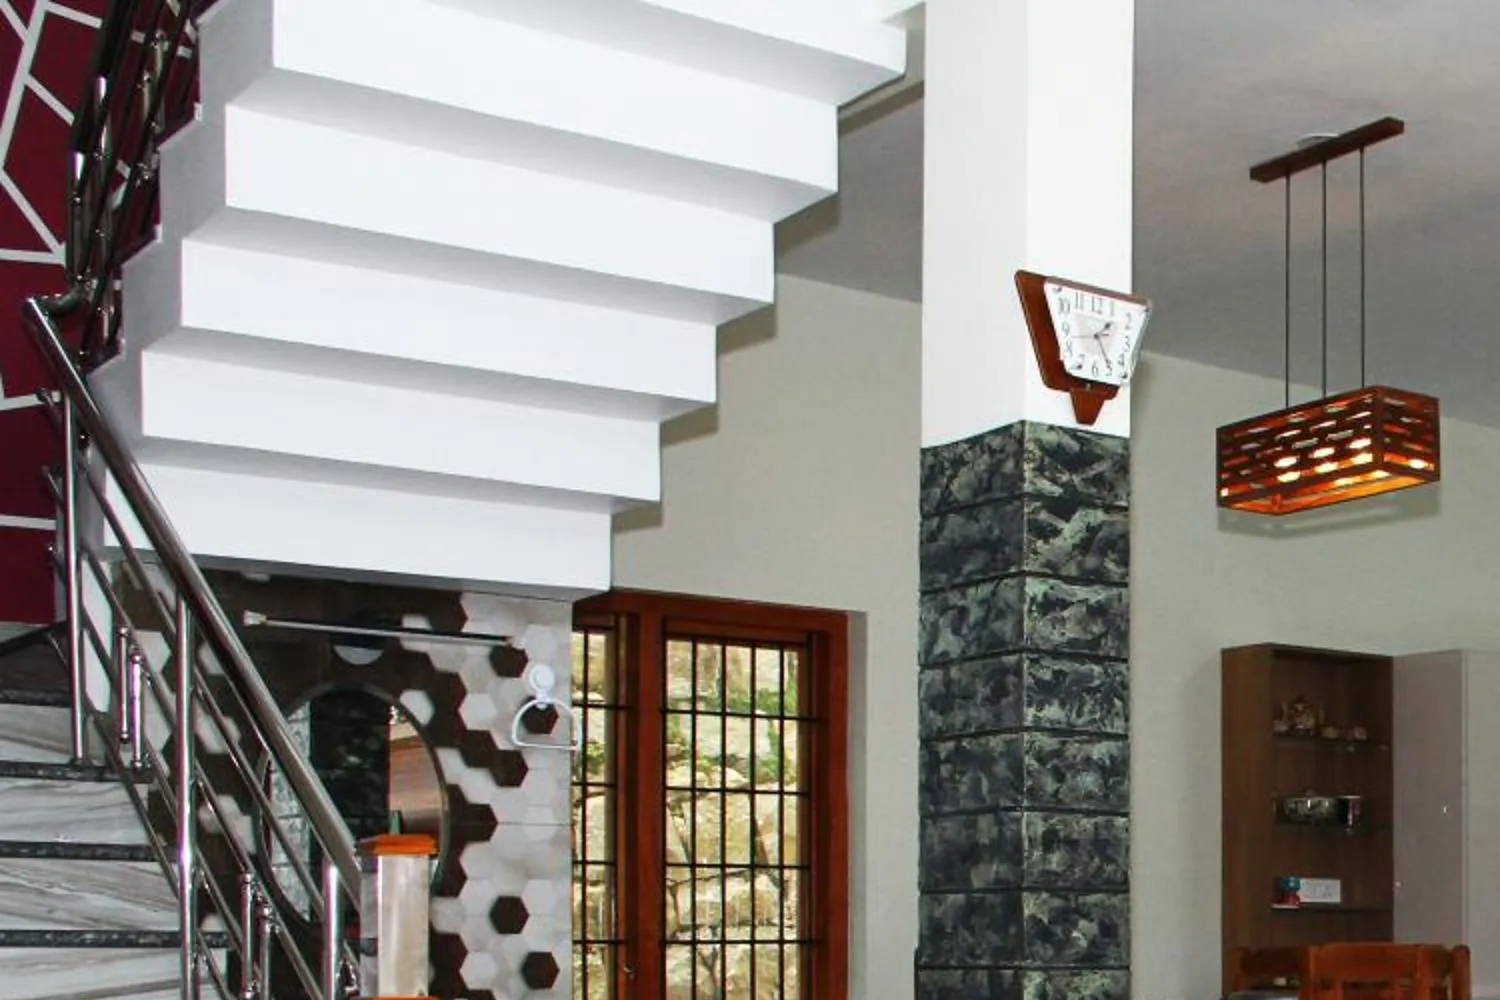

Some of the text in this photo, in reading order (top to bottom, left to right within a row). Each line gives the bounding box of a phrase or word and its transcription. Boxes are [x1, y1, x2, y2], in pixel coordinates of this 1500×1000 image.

[1058, 297, 1071, 315] 10
[1075, 292, 1084, 310] 11
[1091, 296, 1103, 315] 12
[1061, 321, 1070, 337] 9
[1122, 335, 1130, 352] 3
[1091, 361, 1099, 378] 6
